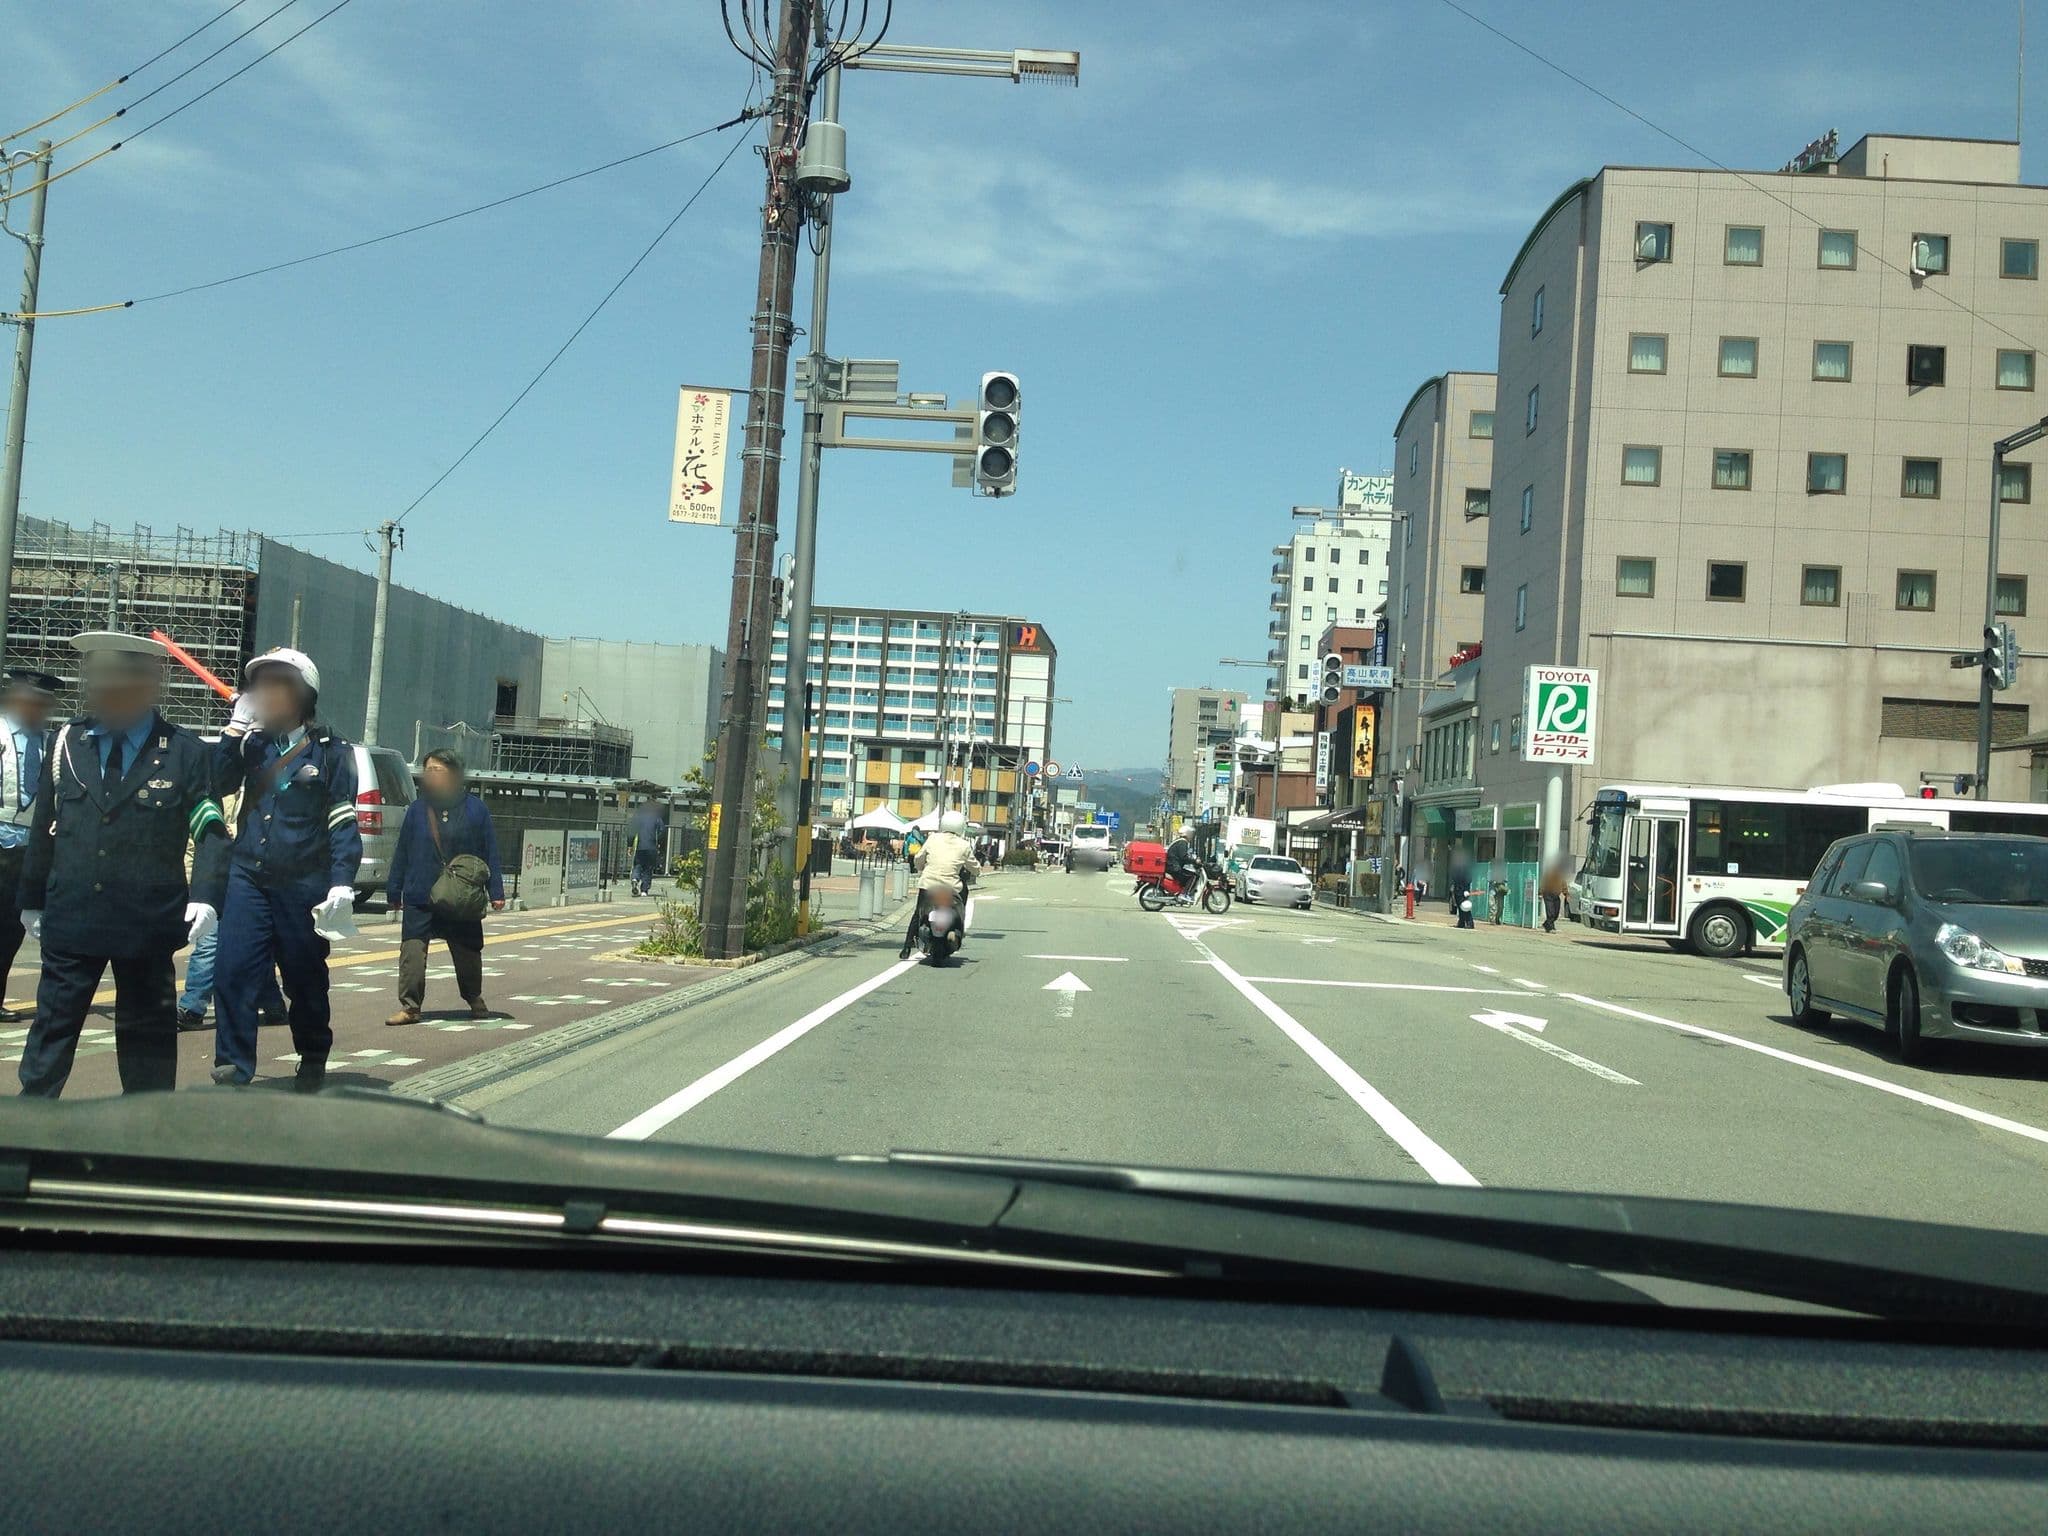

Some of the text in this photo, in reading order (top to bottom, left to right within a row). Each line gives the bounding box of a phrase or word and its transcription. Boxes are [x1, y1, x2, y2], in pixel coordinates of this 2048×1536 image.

[711, 399, 724, 457] HOTEL HANA
[690, 502, 716, 512] 500m
[1537, 670, 1592, 684] TOYOTA
[1533, 733, 1589, 745] レンタカー
[1533, 746, 1589, 758] カーリース
